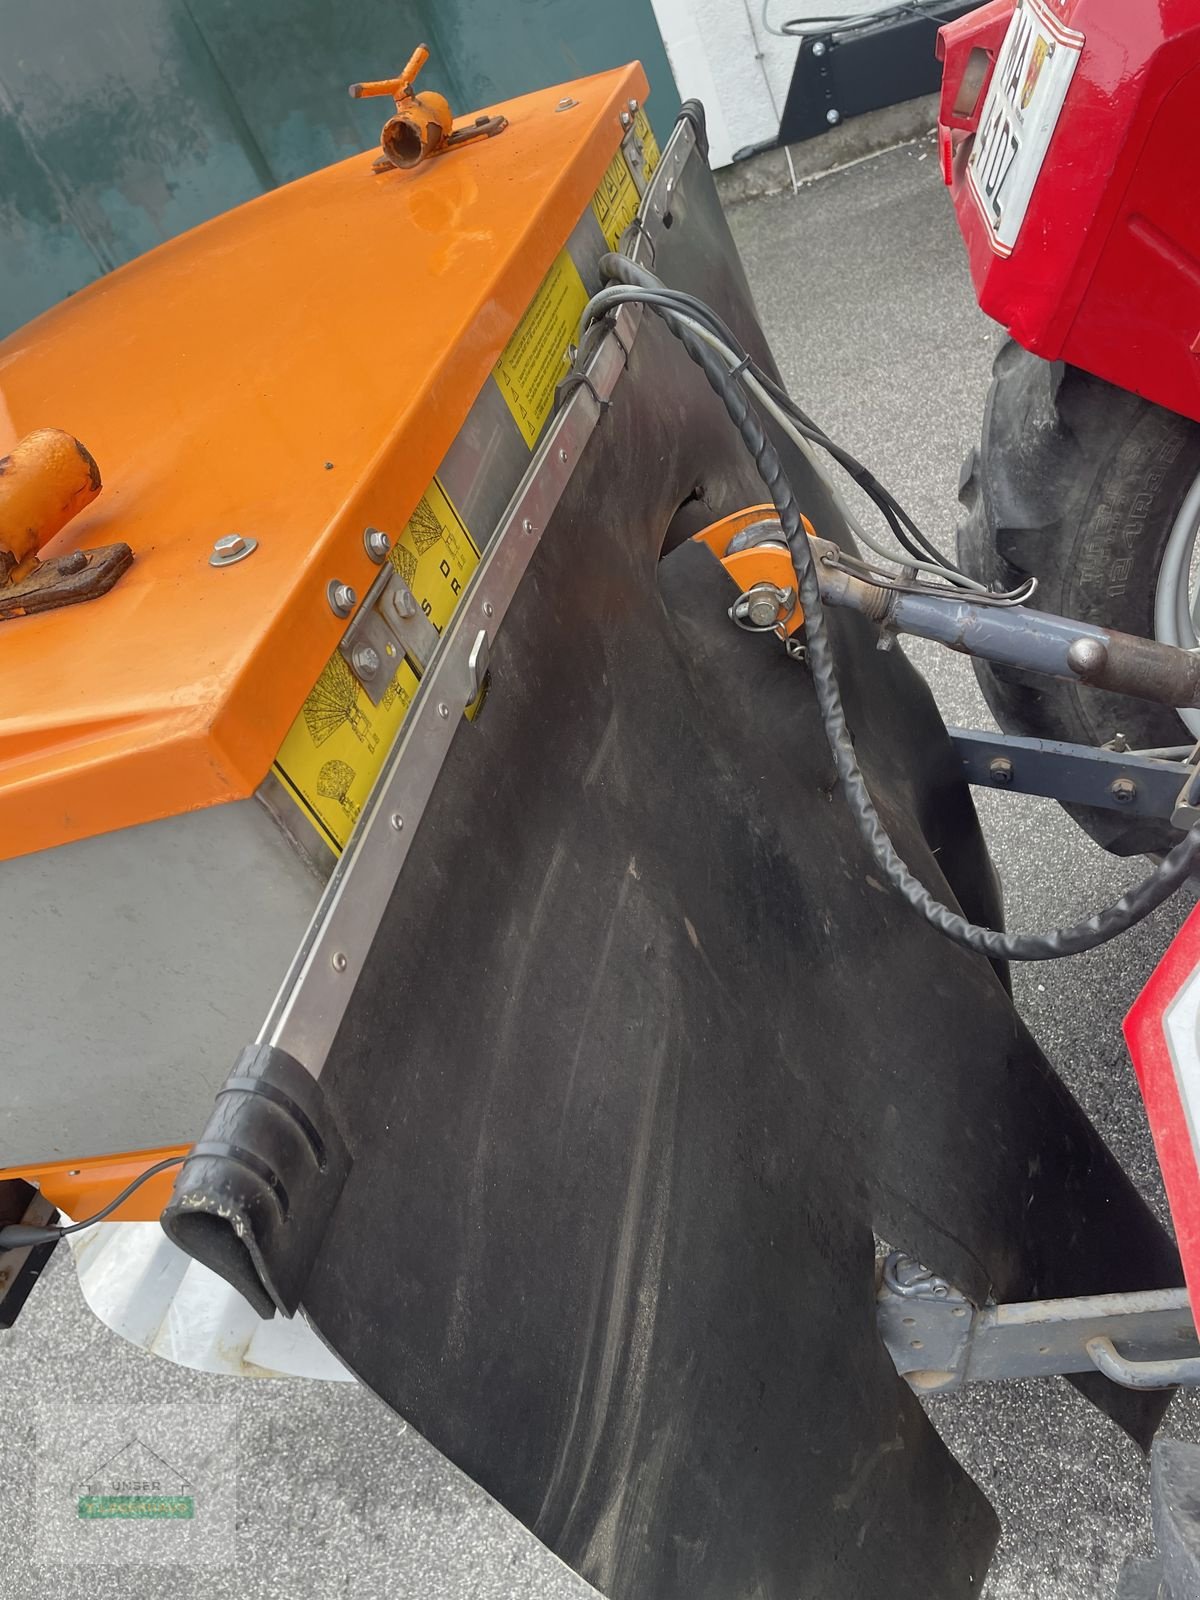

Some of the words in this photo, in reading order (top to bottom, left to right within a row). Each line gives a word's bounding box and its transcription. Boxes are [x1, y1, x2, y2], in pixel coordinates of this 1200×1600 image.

[440, 560, 450, 578] D
[451, 578, 461, 596] R
[421, 598, 432, 617] S
